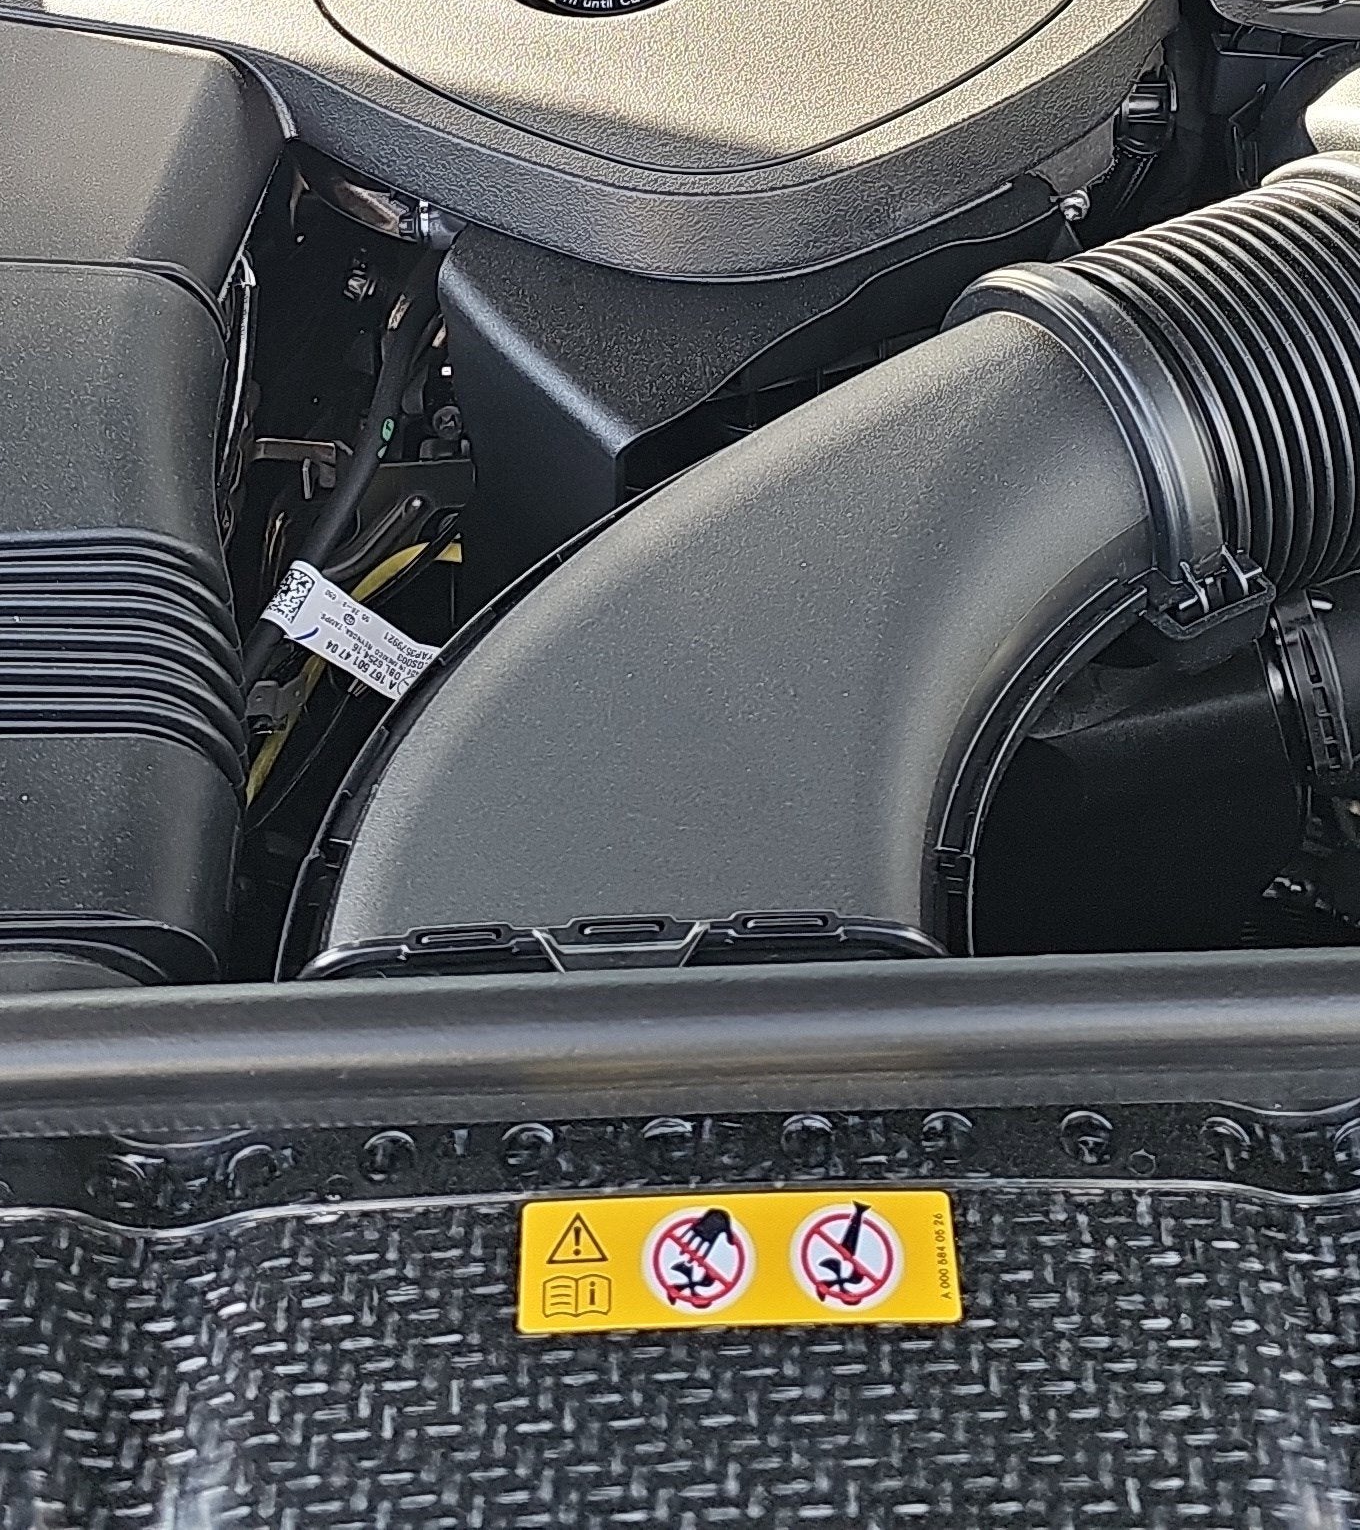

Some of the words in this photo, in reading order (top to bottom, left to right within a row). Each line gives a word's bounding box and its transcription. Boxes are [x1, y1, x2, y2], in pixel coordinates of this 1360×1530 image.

[325, 640, 339, 654] 04
[338, 649, 352, 661] 47
[352, 657, 370, 673] 501
[369, 669, 387, 685] 167
[389, 680, 397, 690] A
[932, 1212, 944, 1226] 26
[939, 1268, 951, 1289] 000
[941, 1291, 952, 1300] A
